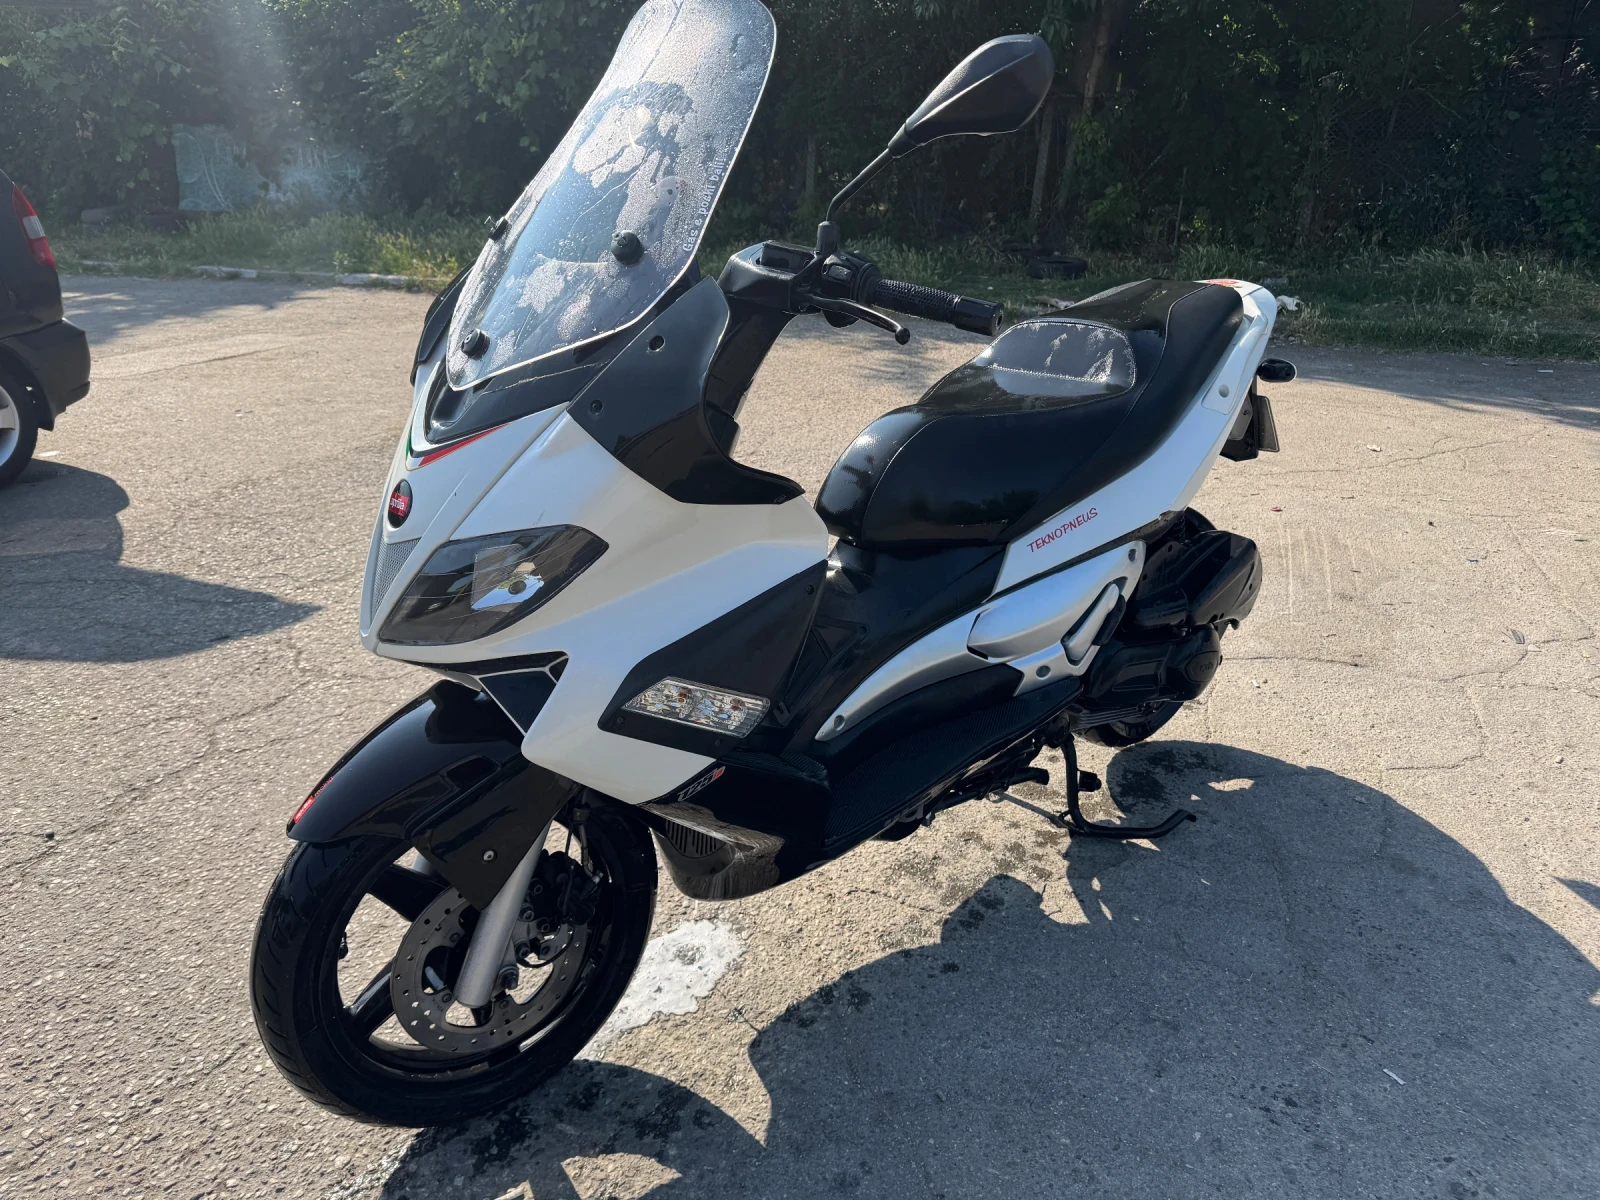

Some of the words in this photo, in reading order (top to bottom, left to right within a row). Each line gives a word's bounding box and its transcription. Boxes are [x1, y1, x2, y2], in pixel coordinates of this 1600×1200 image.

[682, 229, 698, 252] Gas
[694, 218, 703, 227] e
[1026, 507, 1098, 552] TEKNOPNEUS
